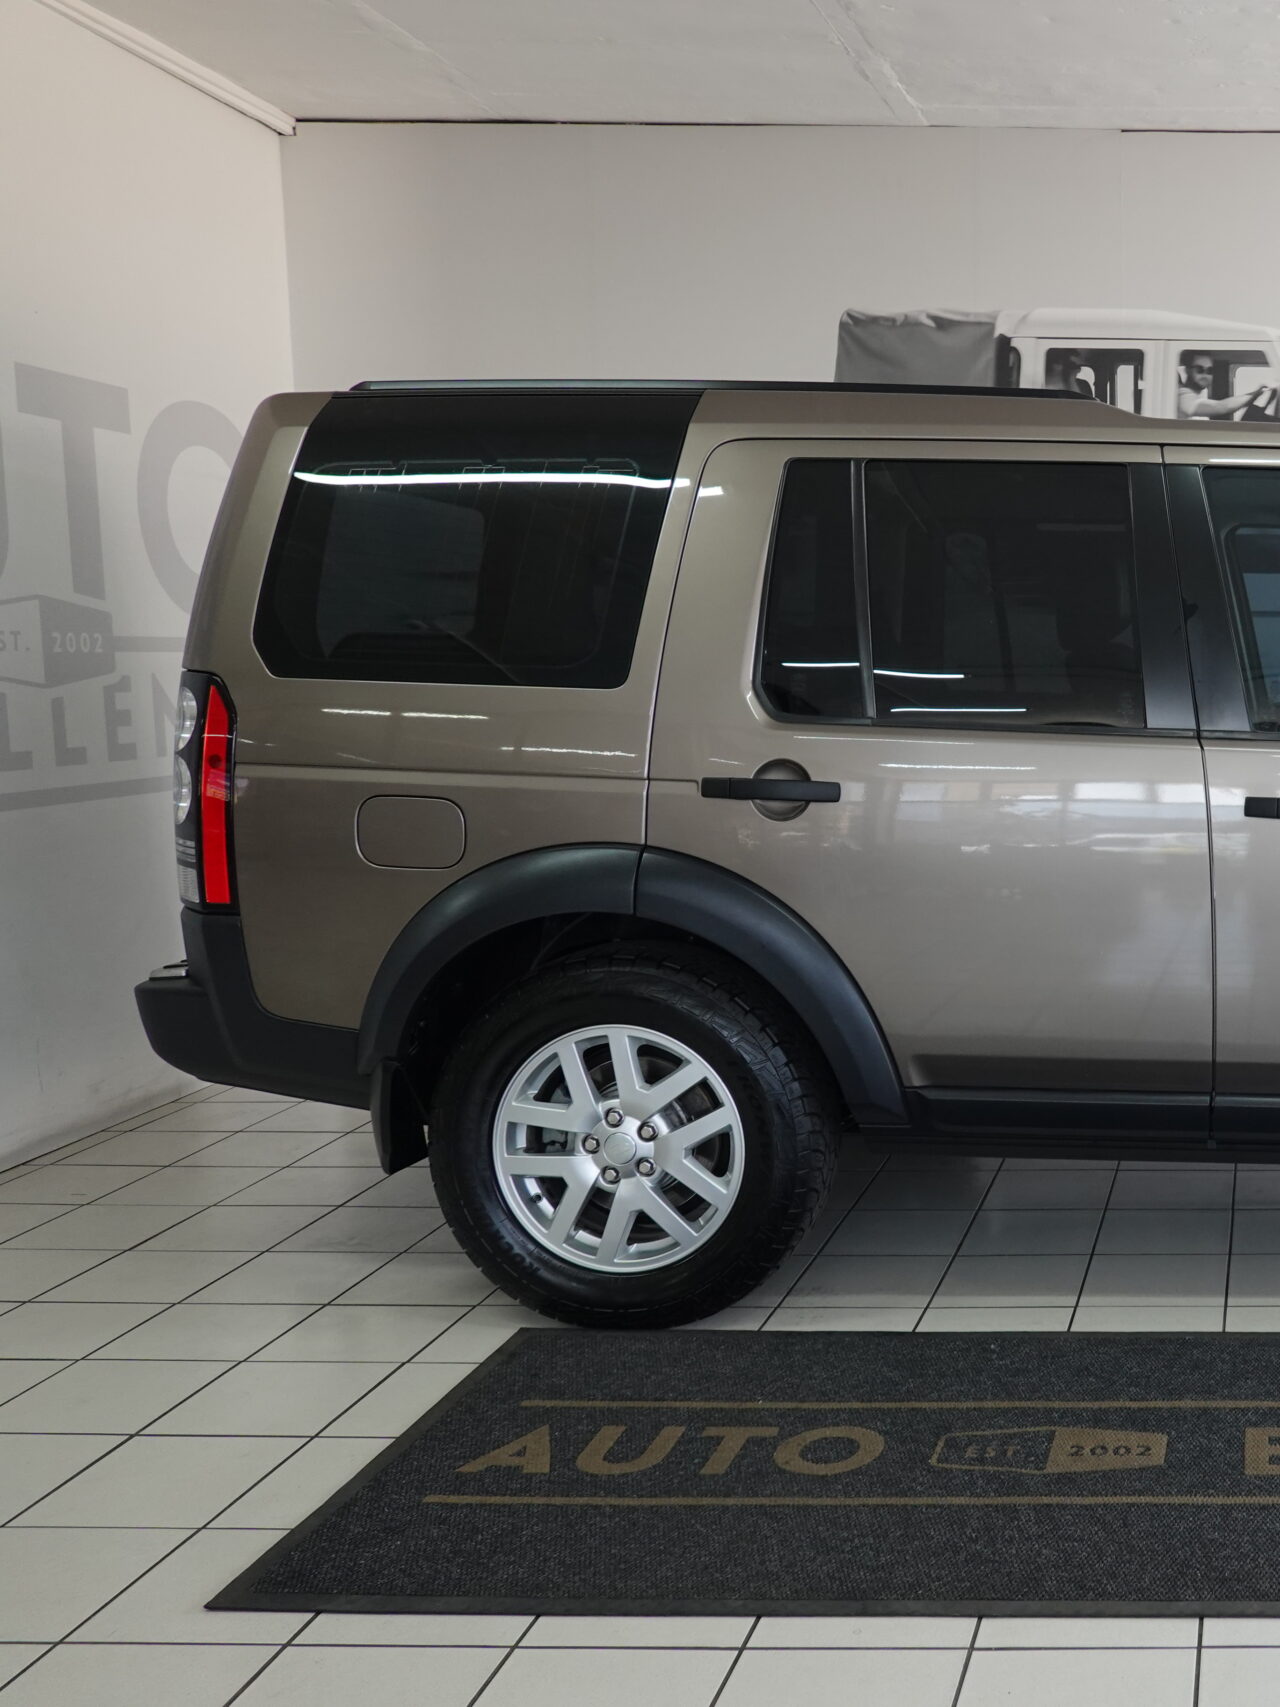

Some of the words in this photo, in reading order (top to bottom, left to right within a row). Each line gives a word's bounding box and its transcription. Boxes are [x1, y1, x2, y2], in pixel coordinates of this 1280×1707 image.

[52, 632, 103, 653] 2002
[455, 1424, 885, 1476] AUTO
[1068, 1444, 1152, 1458] 2002
